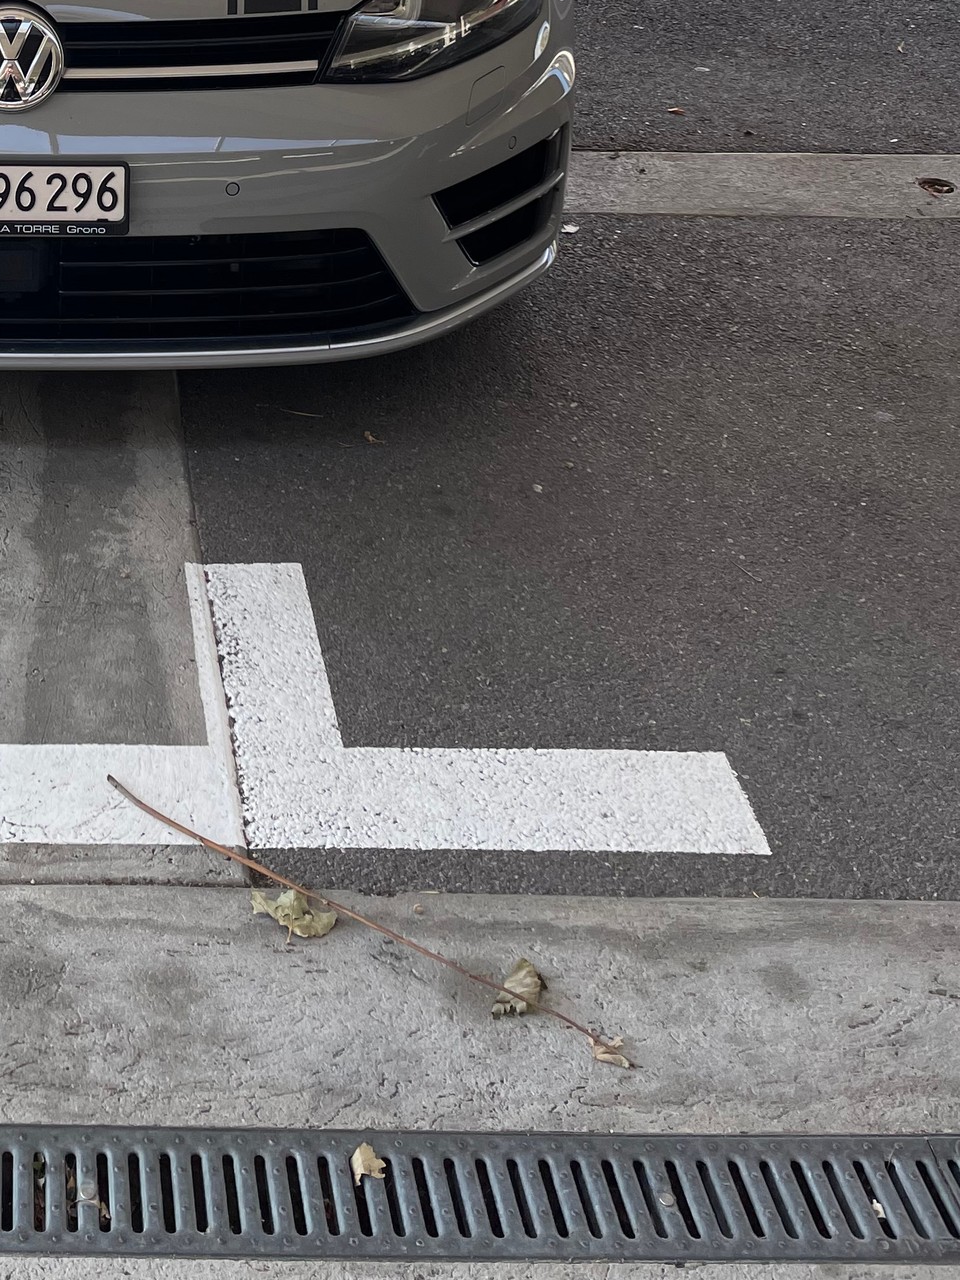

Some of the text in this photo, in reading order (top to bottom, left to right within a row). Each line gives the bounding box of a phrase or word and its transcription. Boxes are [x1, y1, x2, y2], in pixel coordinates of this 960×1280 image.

[46, 171, 119, 213] 296
[14, 224, 60, 233] TORRE
[66, 225, 106, 234] Grono
